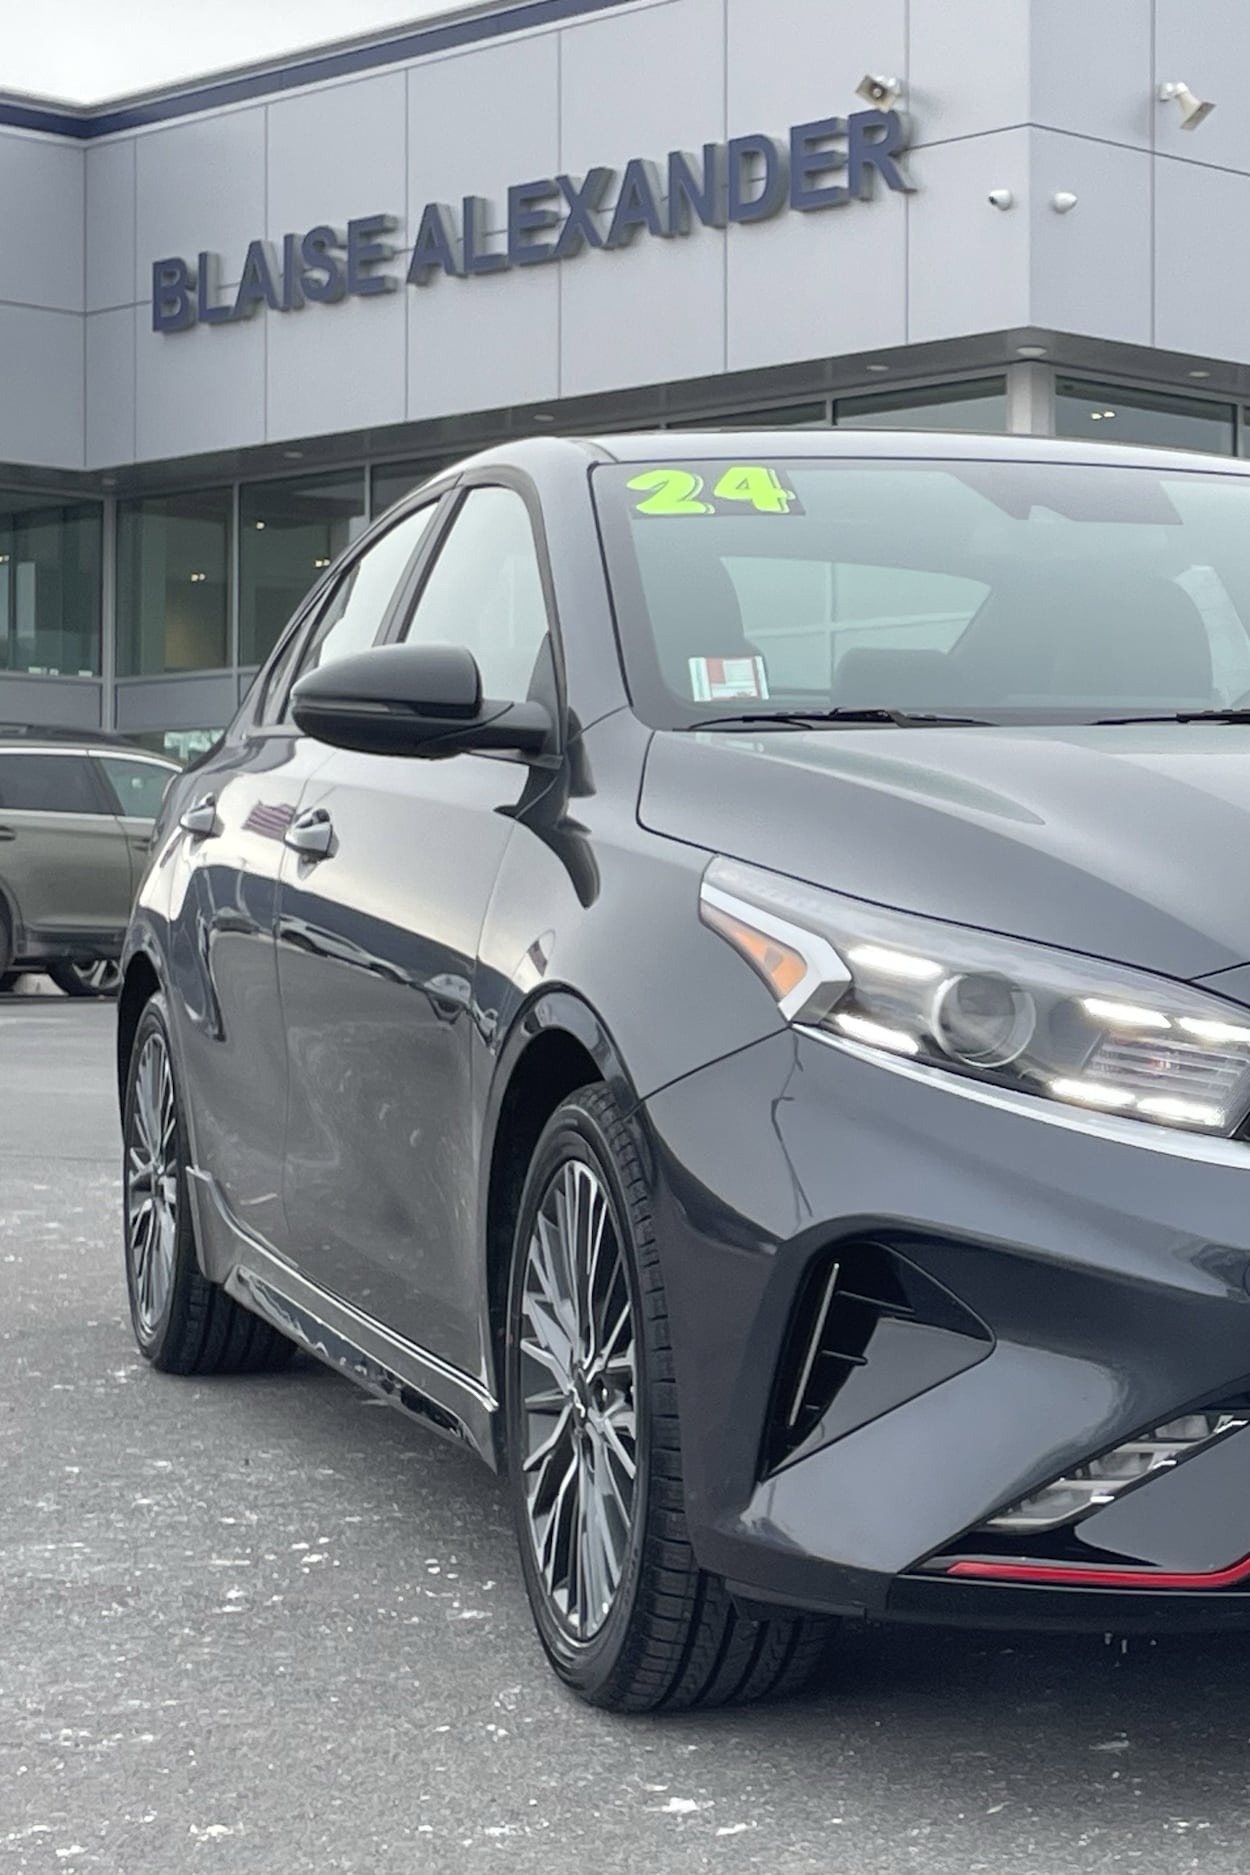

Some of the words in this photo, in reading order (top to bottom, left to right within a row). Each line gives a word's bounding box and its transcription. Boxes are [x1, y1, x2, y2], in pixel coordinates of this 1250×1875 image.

[152, 213, 399, 334] BLAISE
[406, 108, 916, 286] ALEXANDER
[625, 466, 796, 515] 24
